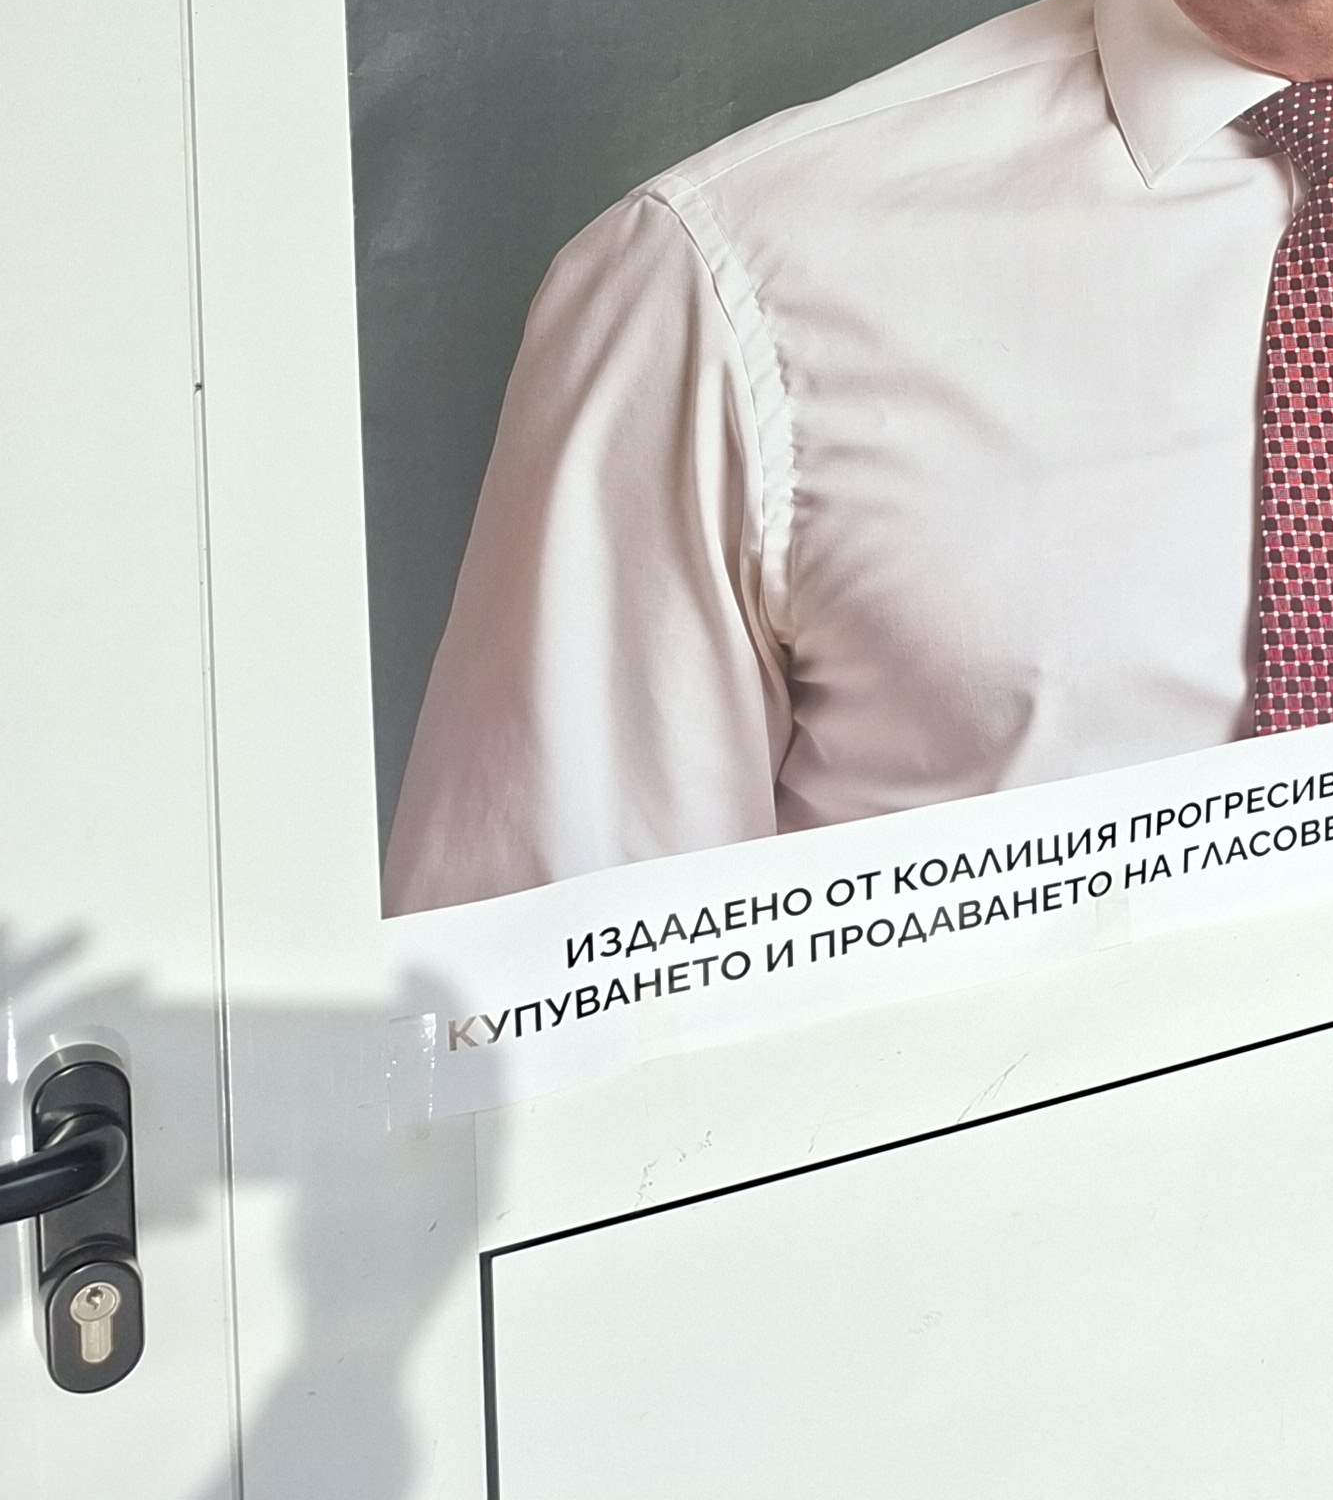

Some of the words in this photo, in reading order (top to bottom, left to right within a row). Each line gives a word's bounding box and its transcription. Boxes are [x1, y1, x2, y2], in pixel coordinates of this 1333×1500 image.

[447, 951, 752, 1052] КУПУВАНЕТО
[766, 938, 795, 973] И
[810, 870, 1113, 963] ПРОДАВАНЕТО
[1124, 854, 1172, 889] НА
[566, 888, 811, 968] ИЗДАДЕНО
[826, 871, 883, 906] ОТ
[894, 822, 1118, 893] КОАЛИЦИЯ
